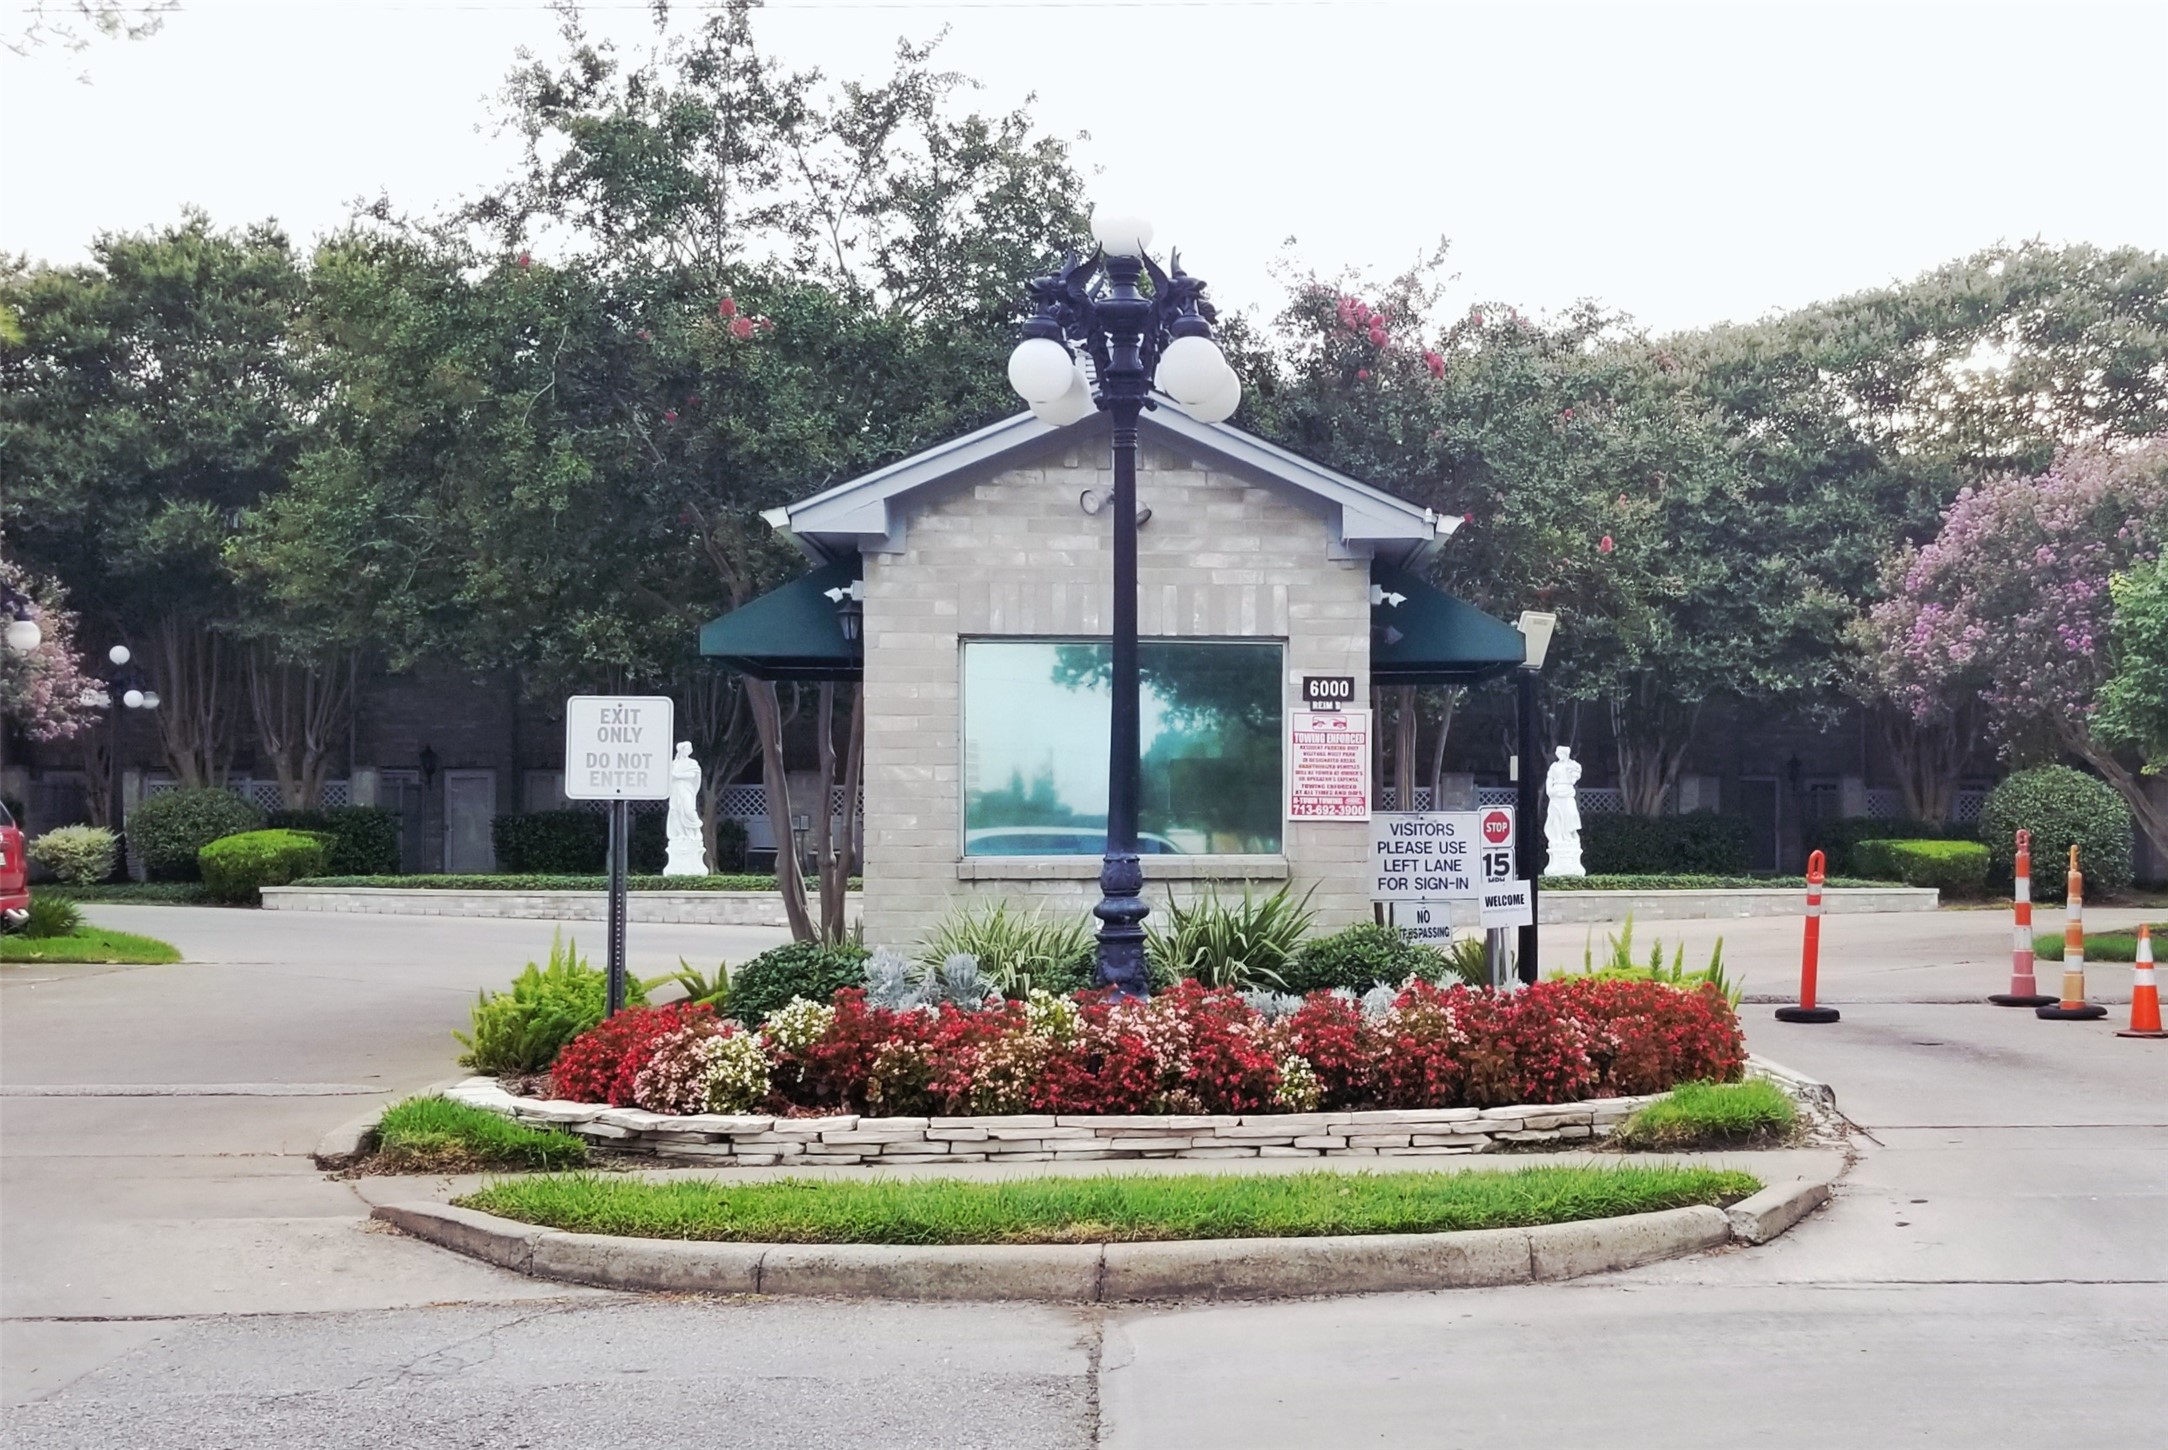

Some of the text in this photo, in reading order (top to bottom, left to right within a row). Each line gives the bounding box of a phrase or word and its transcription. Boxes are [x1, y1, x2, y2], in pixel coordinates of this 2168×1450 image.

[1310, 680, 1349, 697] 6000
[600, 708, 641, 725] EXIT
[597, 726, 643, 743] ONLY
[1294, 733, 1365, 744] TOWING ENFORCED
[586, 752, 653, 769] DO NOT
[589, 770, 648, 787] ENTER
[1292, 804, 1365, 815] 713-692-3900
[1389, 822, 1455, 837] VISITORS
[1486, 822, 1508, 833] STOP
[1377, 841, 1467, 854] PLEASE USE
[1383, 859, 1462, 872] LEFT LANE
[1482, 852, 1510, 877] 15
[1378, 877, 1469, 890] FOR SIGN-IN
[1485, 893, 1525, 908] WELCOME
[1417, 909, 1431, 924] NO
